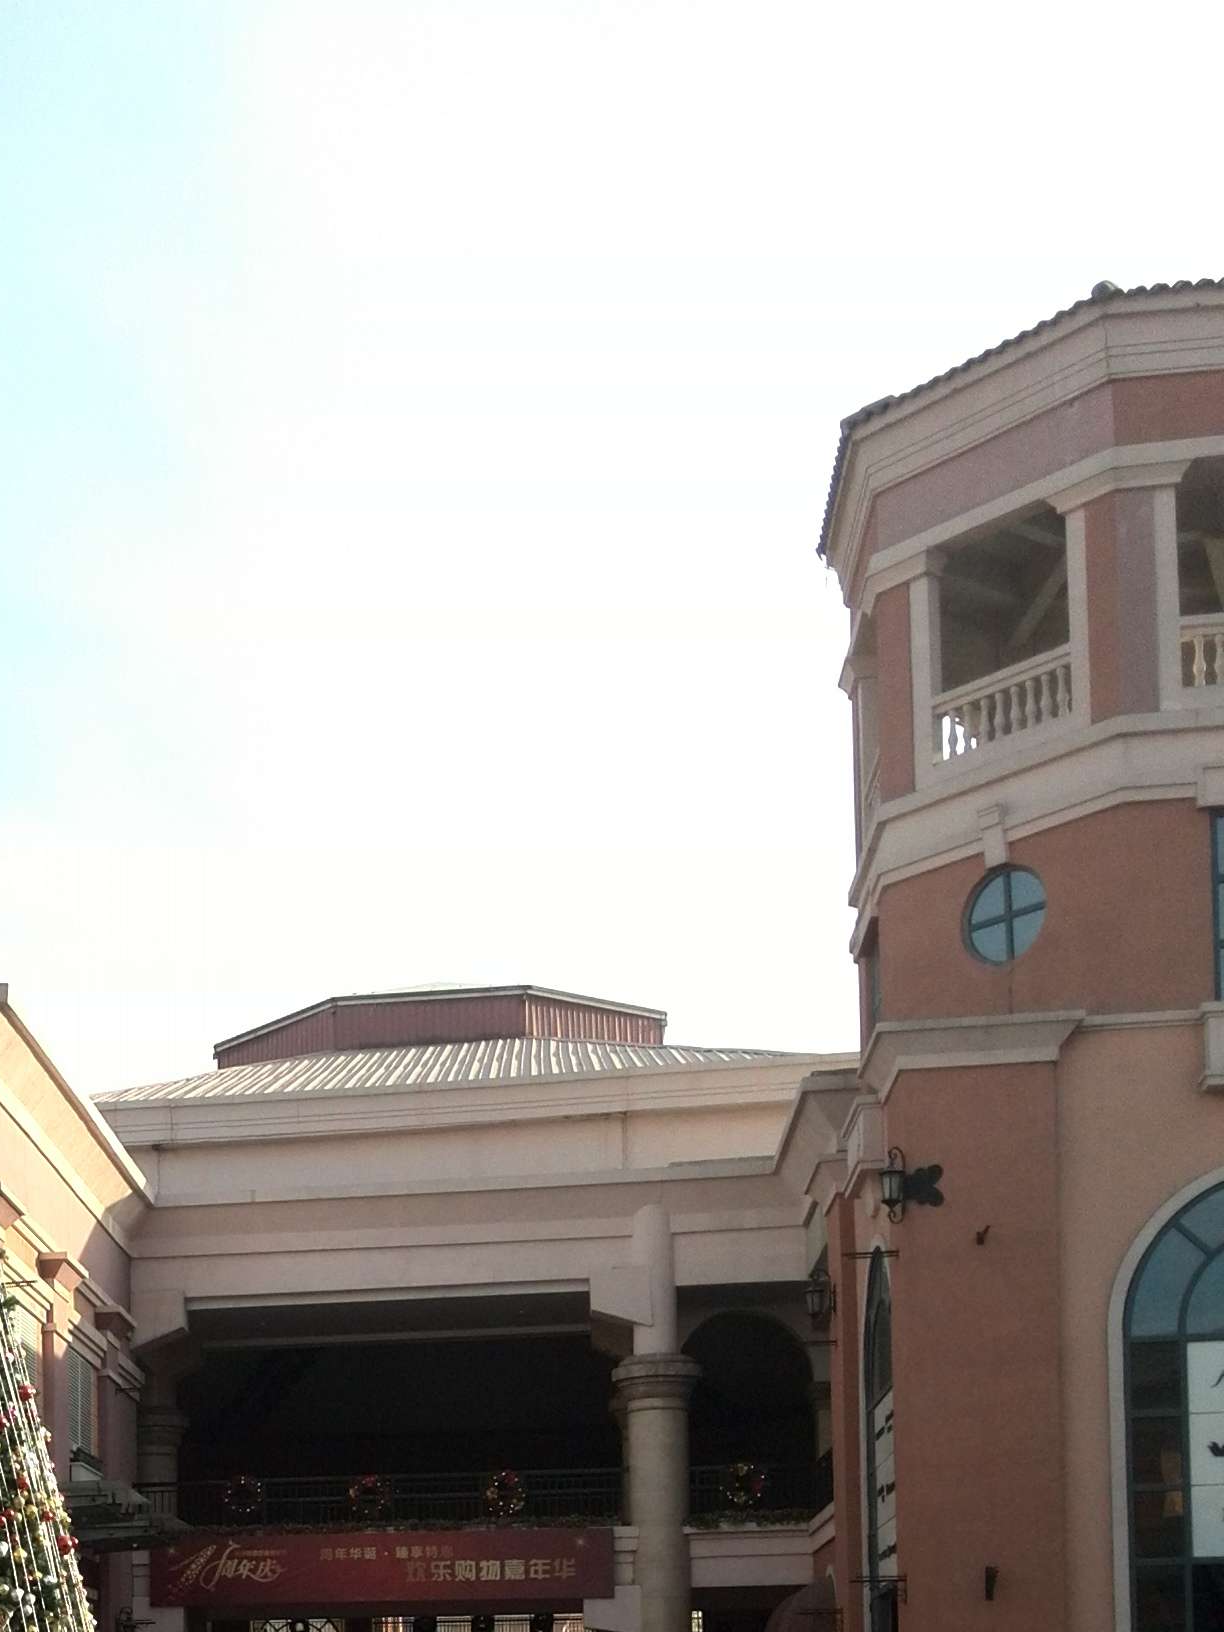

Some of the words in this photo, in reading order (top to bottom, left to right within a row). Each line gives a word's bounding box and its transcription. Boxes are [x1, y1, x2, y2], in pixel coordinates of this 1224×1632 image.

[406, 1558, 576, 1582] 欢乐购物嘉年华
